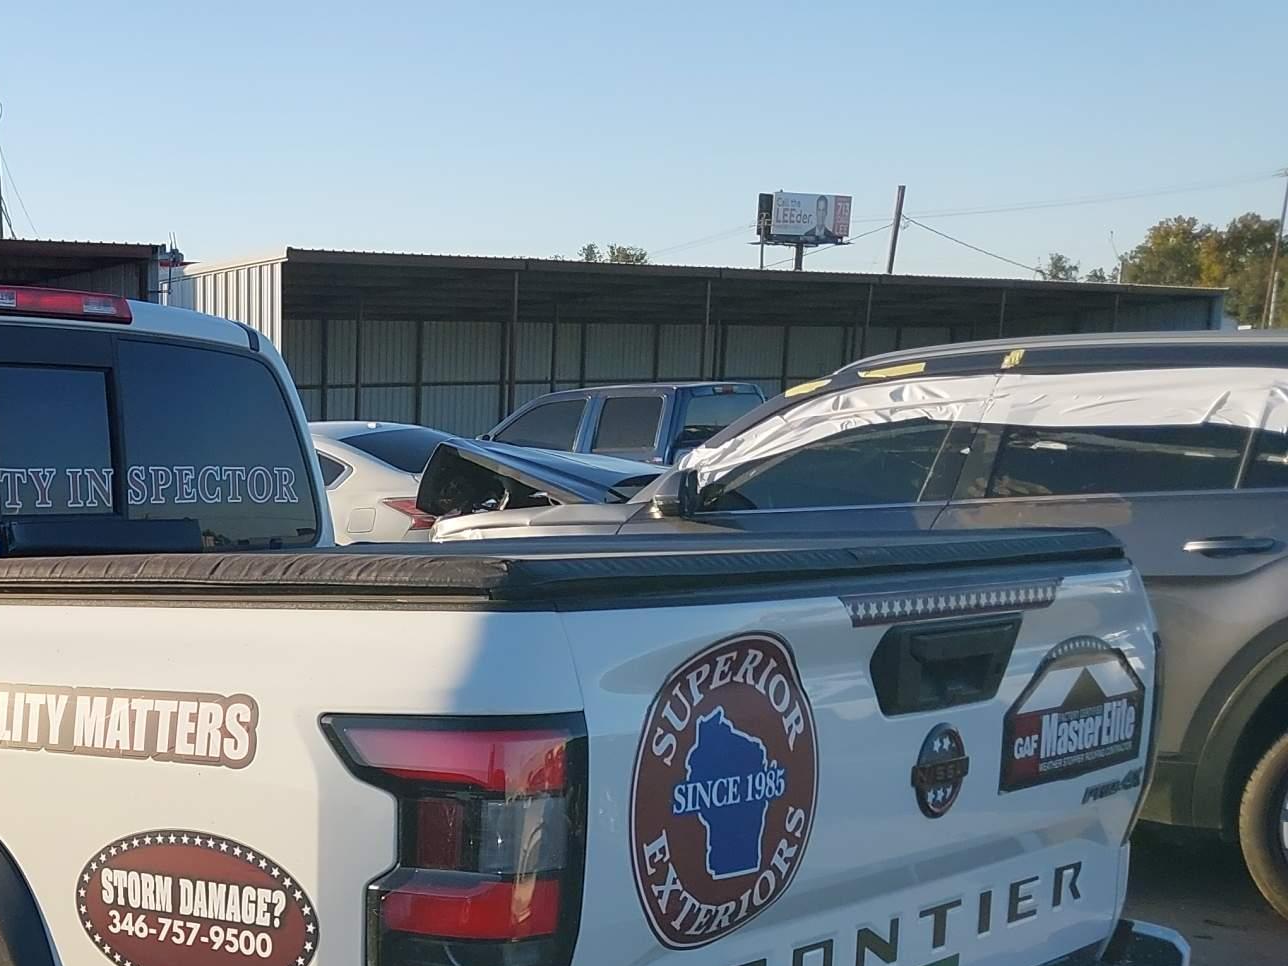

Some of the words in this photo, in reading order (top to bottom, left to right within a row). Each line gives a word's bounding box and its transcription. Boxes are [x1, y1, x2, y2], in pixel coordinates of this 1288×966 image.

[73, 695, 252, 762] MATTERS
[652, 649, 805, 767] SUPERIOR
[1014, 734, 1039, 760] GAF
[672, 776, 741, 815] SINCE
[745, 768, 786, 803] 1985
[100, 867, 172, 914] STORM
[179, 878, 287, 930] DAMAGE?
[643, 806, 805, 935] EXTERIORS
[107, 910, 273, 959] 346-757-9500
